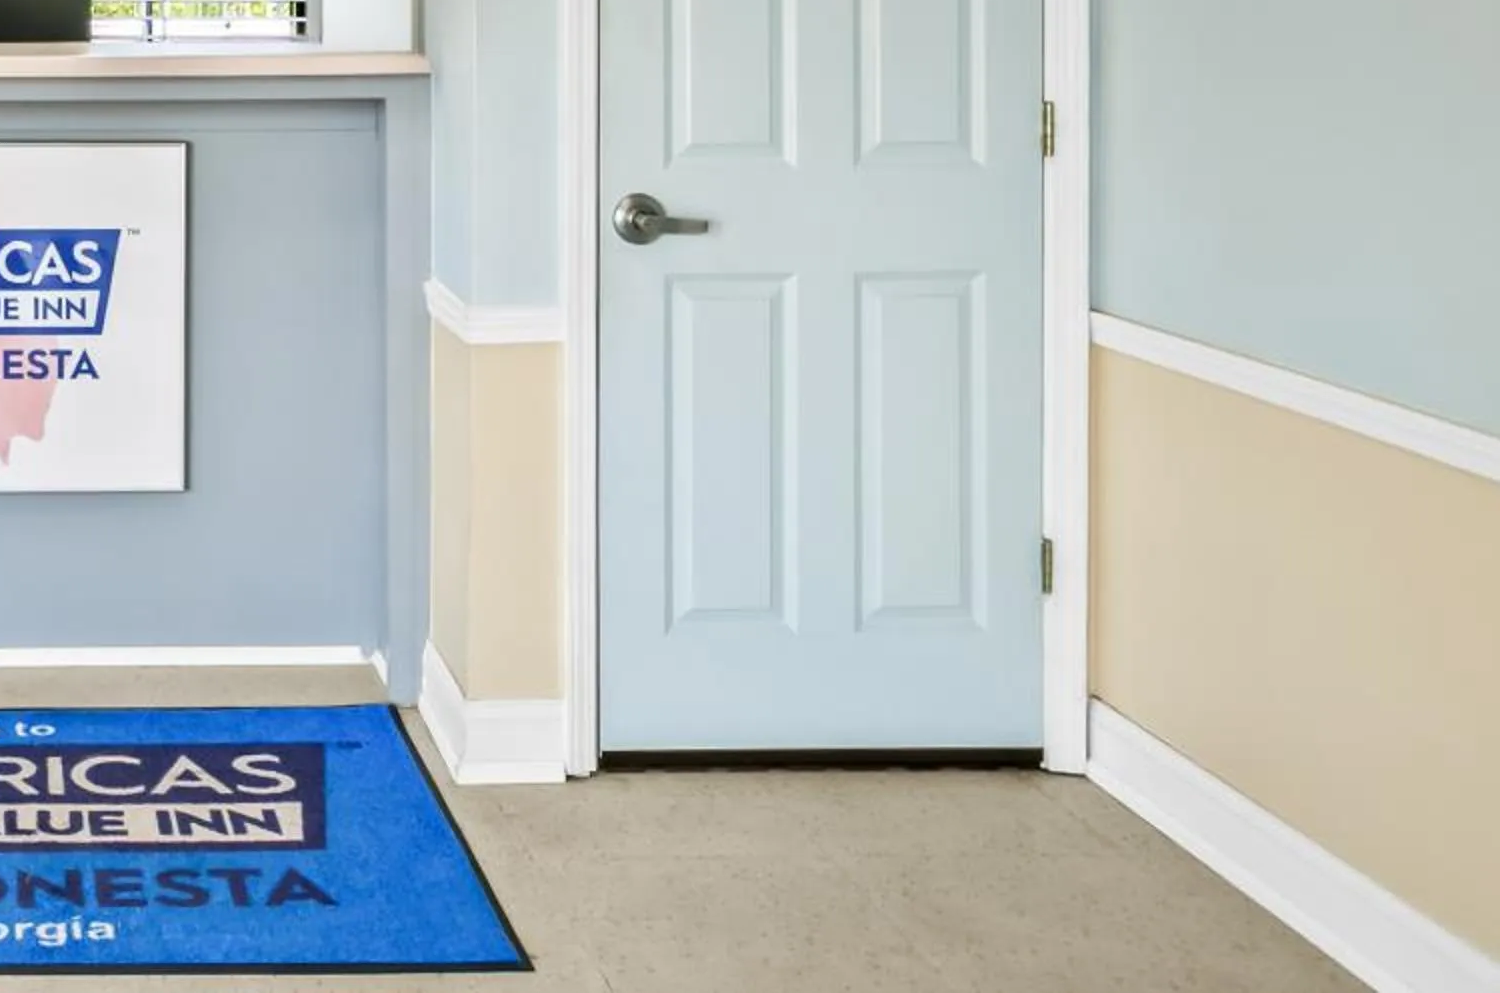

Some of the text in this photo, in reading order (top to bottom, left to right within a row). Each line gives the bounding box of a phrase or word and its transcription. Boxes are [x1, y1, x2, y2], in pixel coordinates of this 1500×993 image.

[33, 296, 87, 320] INN
[14, 721, 56, 737] to
[155, 808, 284, 837] INN
